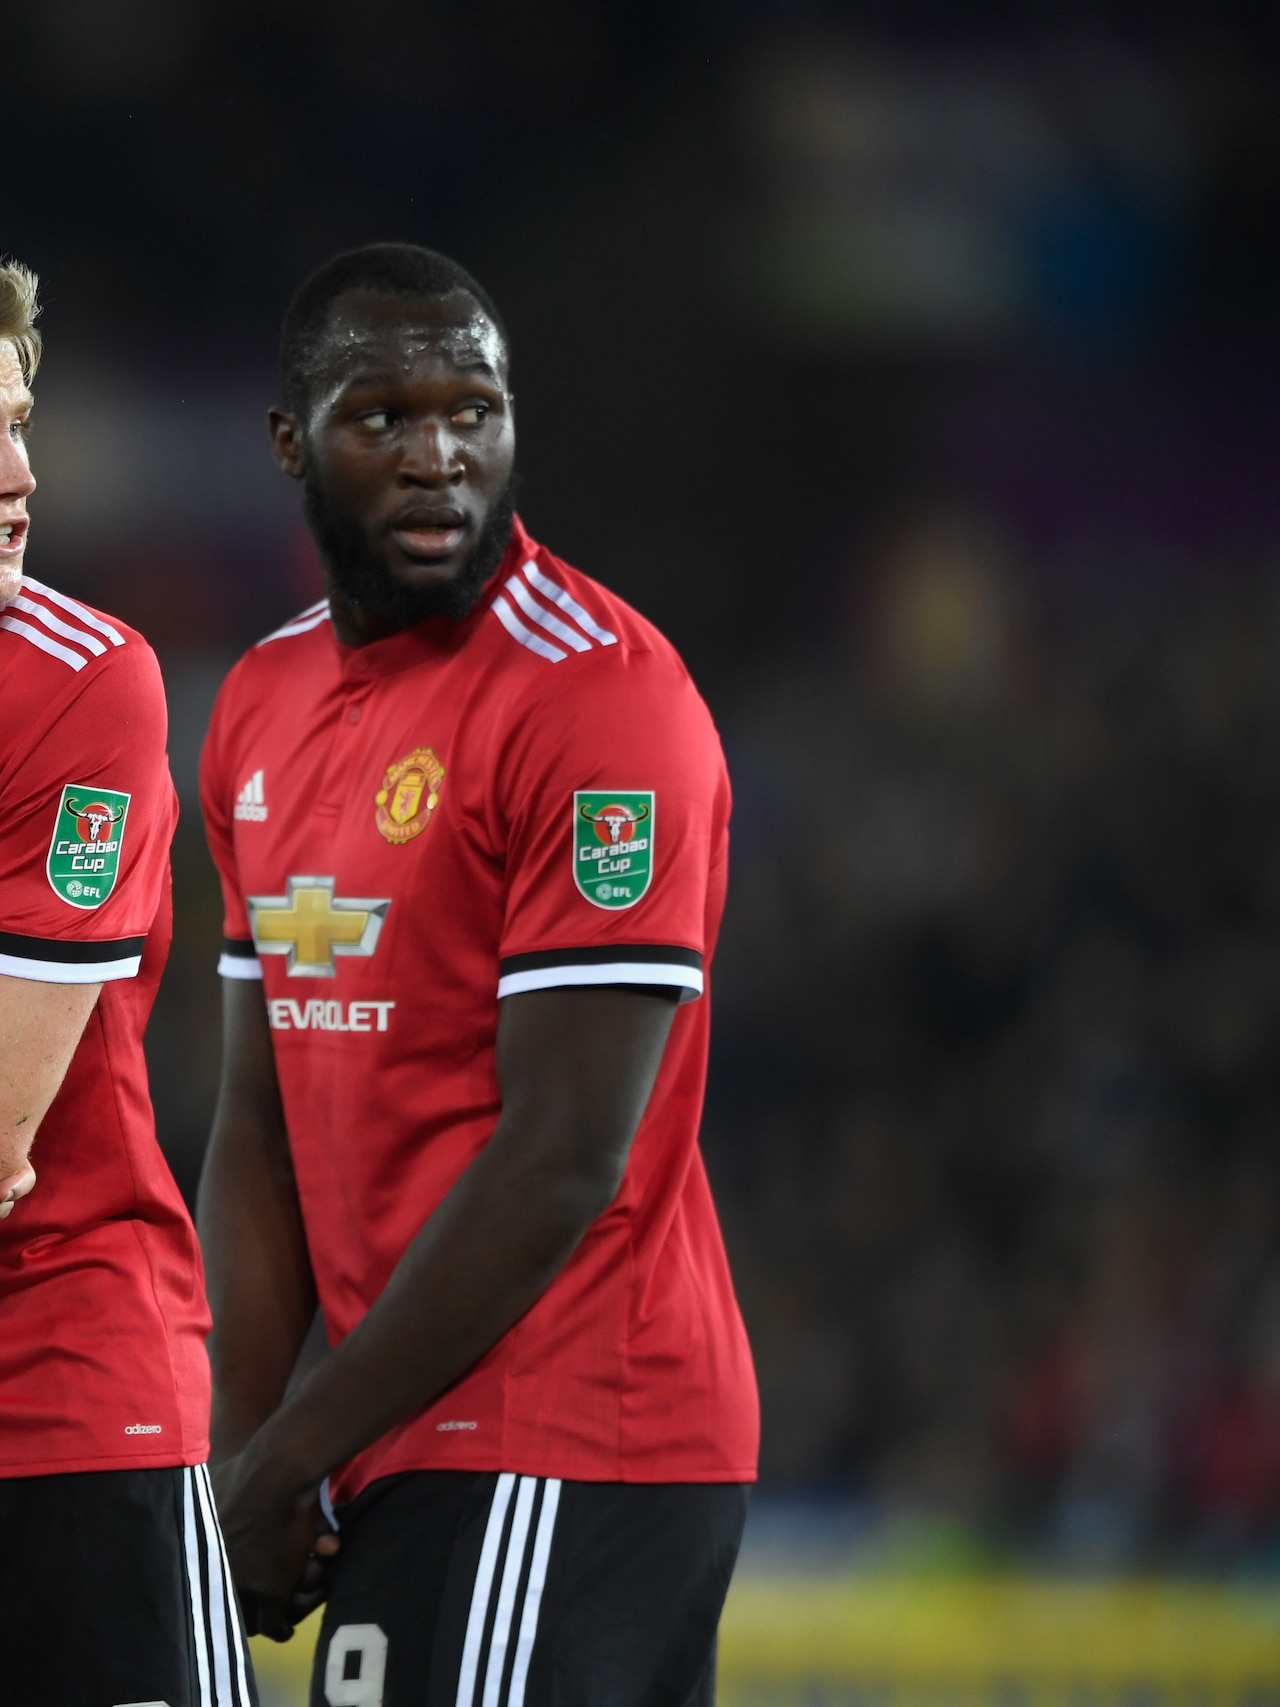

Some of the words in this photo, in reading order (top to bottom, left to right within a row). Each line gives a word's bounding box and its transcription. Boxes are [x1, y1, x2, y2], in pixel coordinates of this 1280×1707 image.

[56, 839, 118, 855] Carabao
[580, 838, 648, 861] Carabao
[71, 855, 105, 872] Cup
[598, 858, 631, 874] Cup
[83, 886, 101, 899] EFL
[612, 887, 632, 898] EFL
[267, 998, 395, 1032] EVROLET
[124, 1423, 162, 1435] adizero
[324, 1623, 388, 1707] 9
